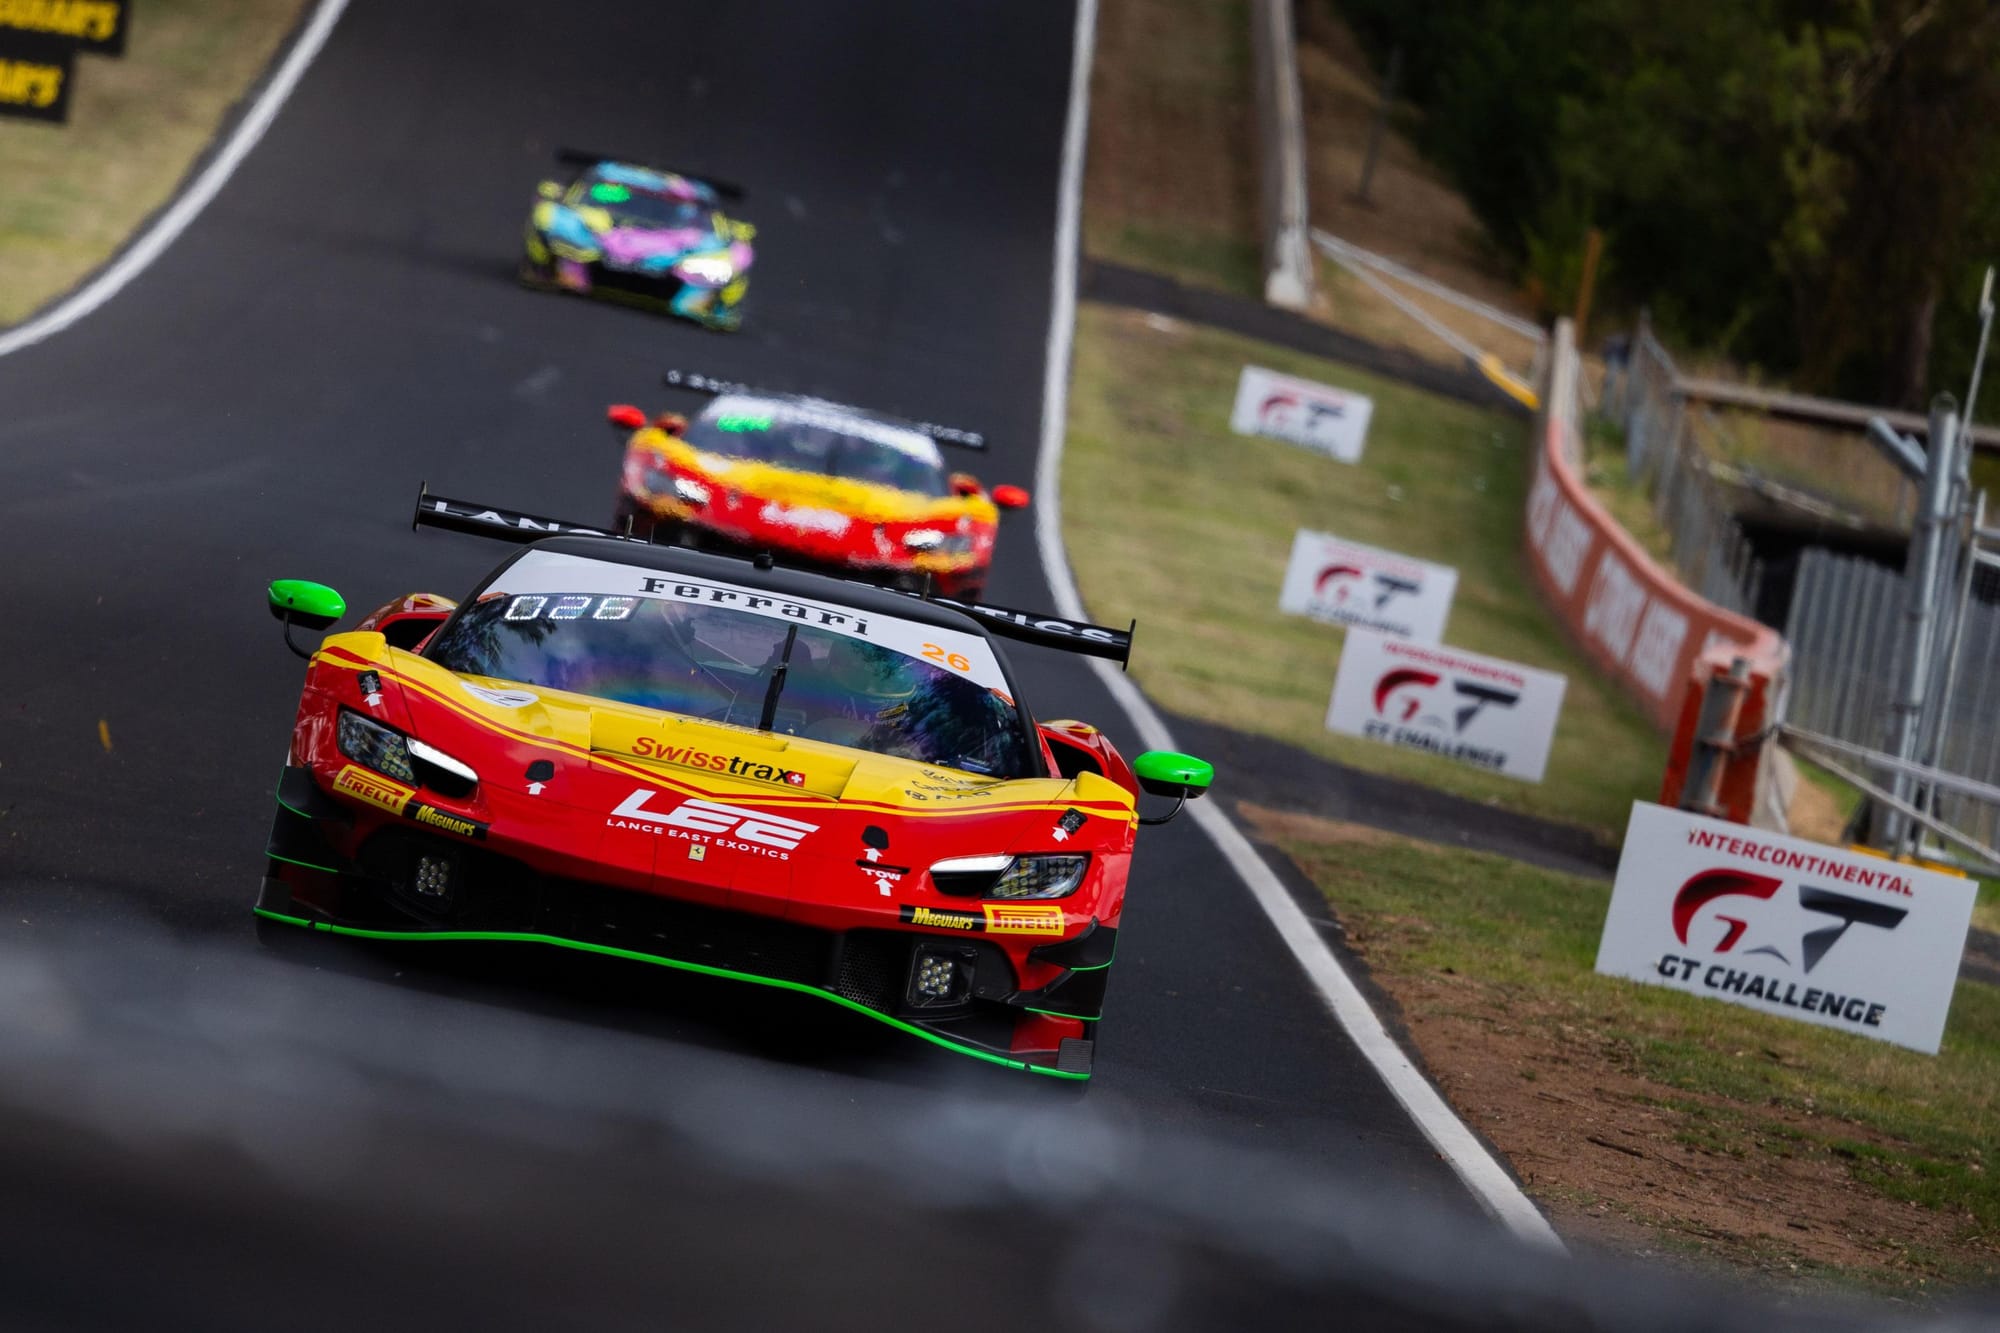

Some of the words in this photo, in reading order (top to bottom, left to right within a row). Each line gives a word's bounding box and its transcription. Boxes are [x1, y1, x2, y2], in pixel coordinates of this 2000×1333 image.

[504, 595, 634, 621] 026
[638, 577, 868, 636] Ferrari
[921, 643, 971, 671] 26
[1373, 666, 1520, 732] GT
[632, 737, 792, 784] Swisstrax
[338, 771, 406, 809] PIRELLI
[606, 818, 664, 835] LANCE
[668, 829, 712, 844] EAST
[716, 838, 790, 861] EXOTICS
[610, 788, 820, 850] LEE
[860, 867, 902, 881] TOW
[1687, 828, 1914, 897] INTERCONTINENTAL
[993, 909, 1060, 931] PIRELLI
[1672, 867, 1909, 975] GT
[1656, 954, 1701, 981] GT
[1704, 965, 1886, 1027] CHALLENGE
